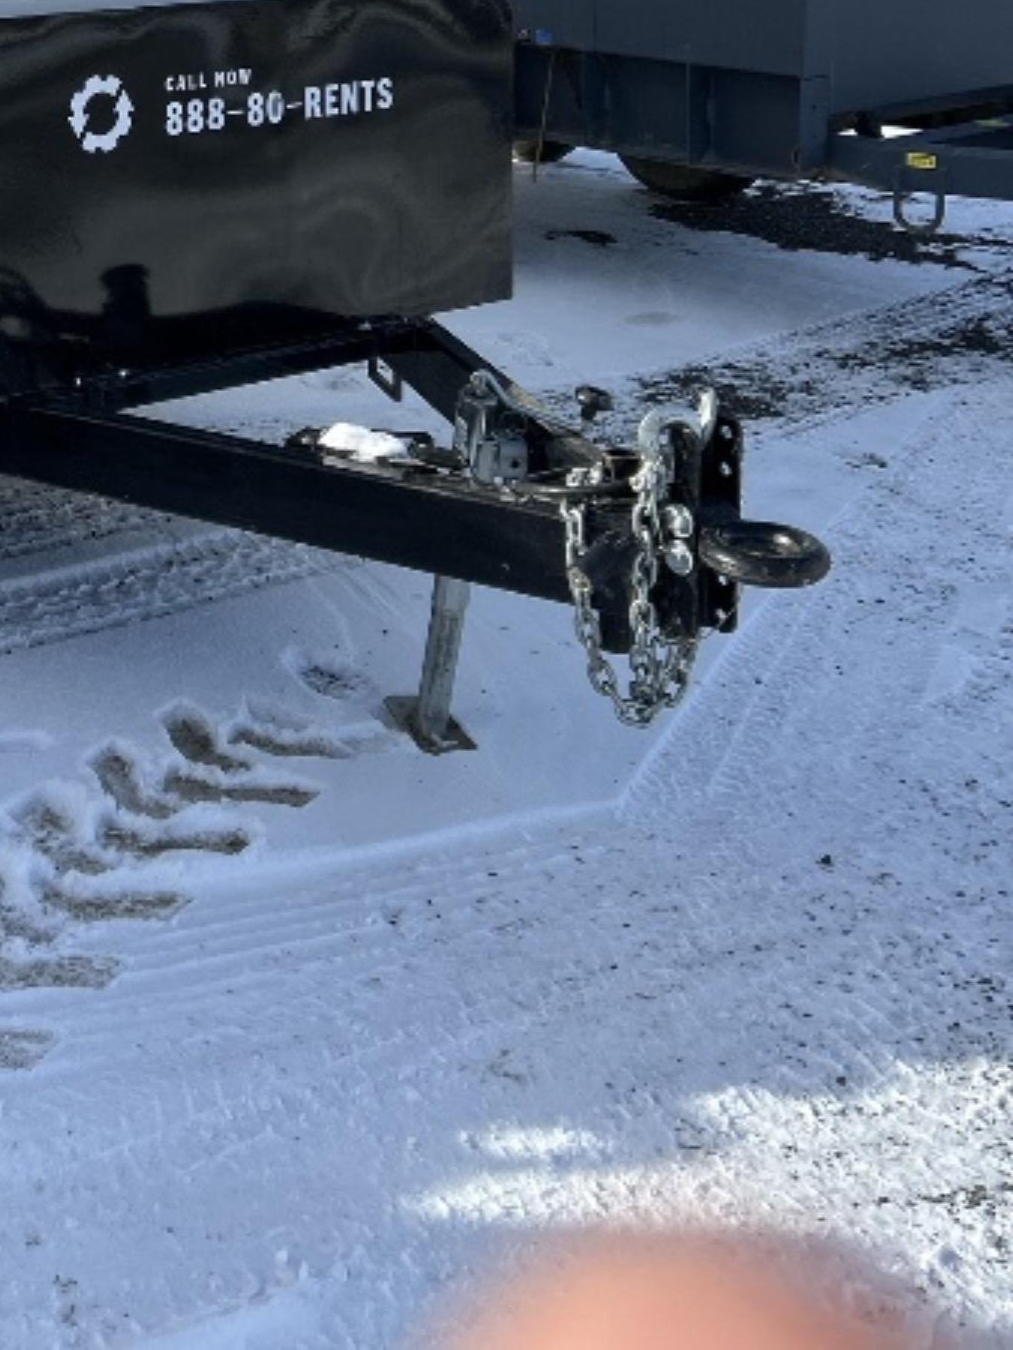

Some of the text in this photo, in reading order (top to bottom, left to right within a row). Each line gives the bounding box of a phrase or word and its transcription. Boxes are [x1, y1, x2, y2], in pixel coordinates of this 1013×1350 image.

[165, 68, 253, 92] CALL NOW
[165, 76, 394, 137] 888-80-RENTS
